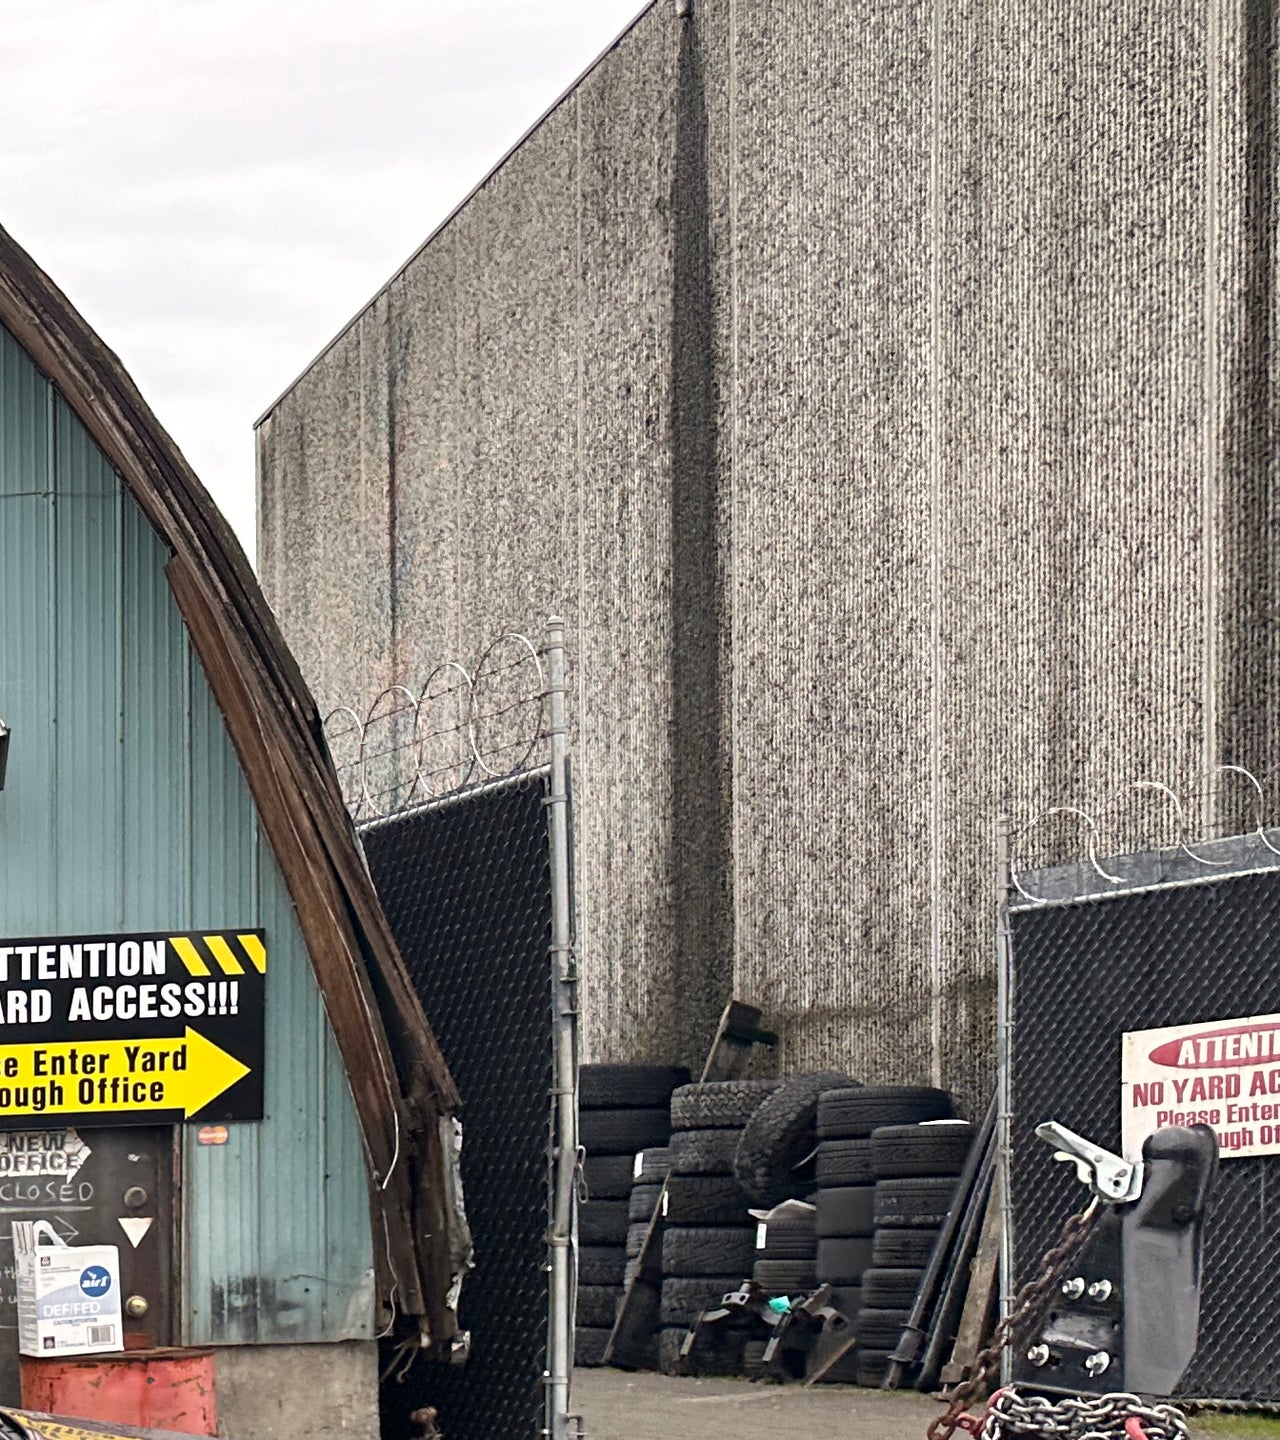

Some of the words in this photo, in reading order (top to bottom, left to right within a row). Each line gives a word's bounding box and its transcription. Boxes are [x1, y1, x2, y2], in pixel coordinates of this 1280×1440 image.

[68, 980, 239, 1021] ACCESS!!!
[33, 1049, 111, 1077] Enter
[124, 1044, 188, 1072] Yard
[79, 1075, 165, 1105] Office
[1133, 1081, 1165, 1108] NO
[1172, 1073, 1241, 1104] YARD
[1157, 1109, 1221, 1129] Please
[1227, 1102, 1280, 1124] Enter
[8, 1133, 65, 1153] NEW
